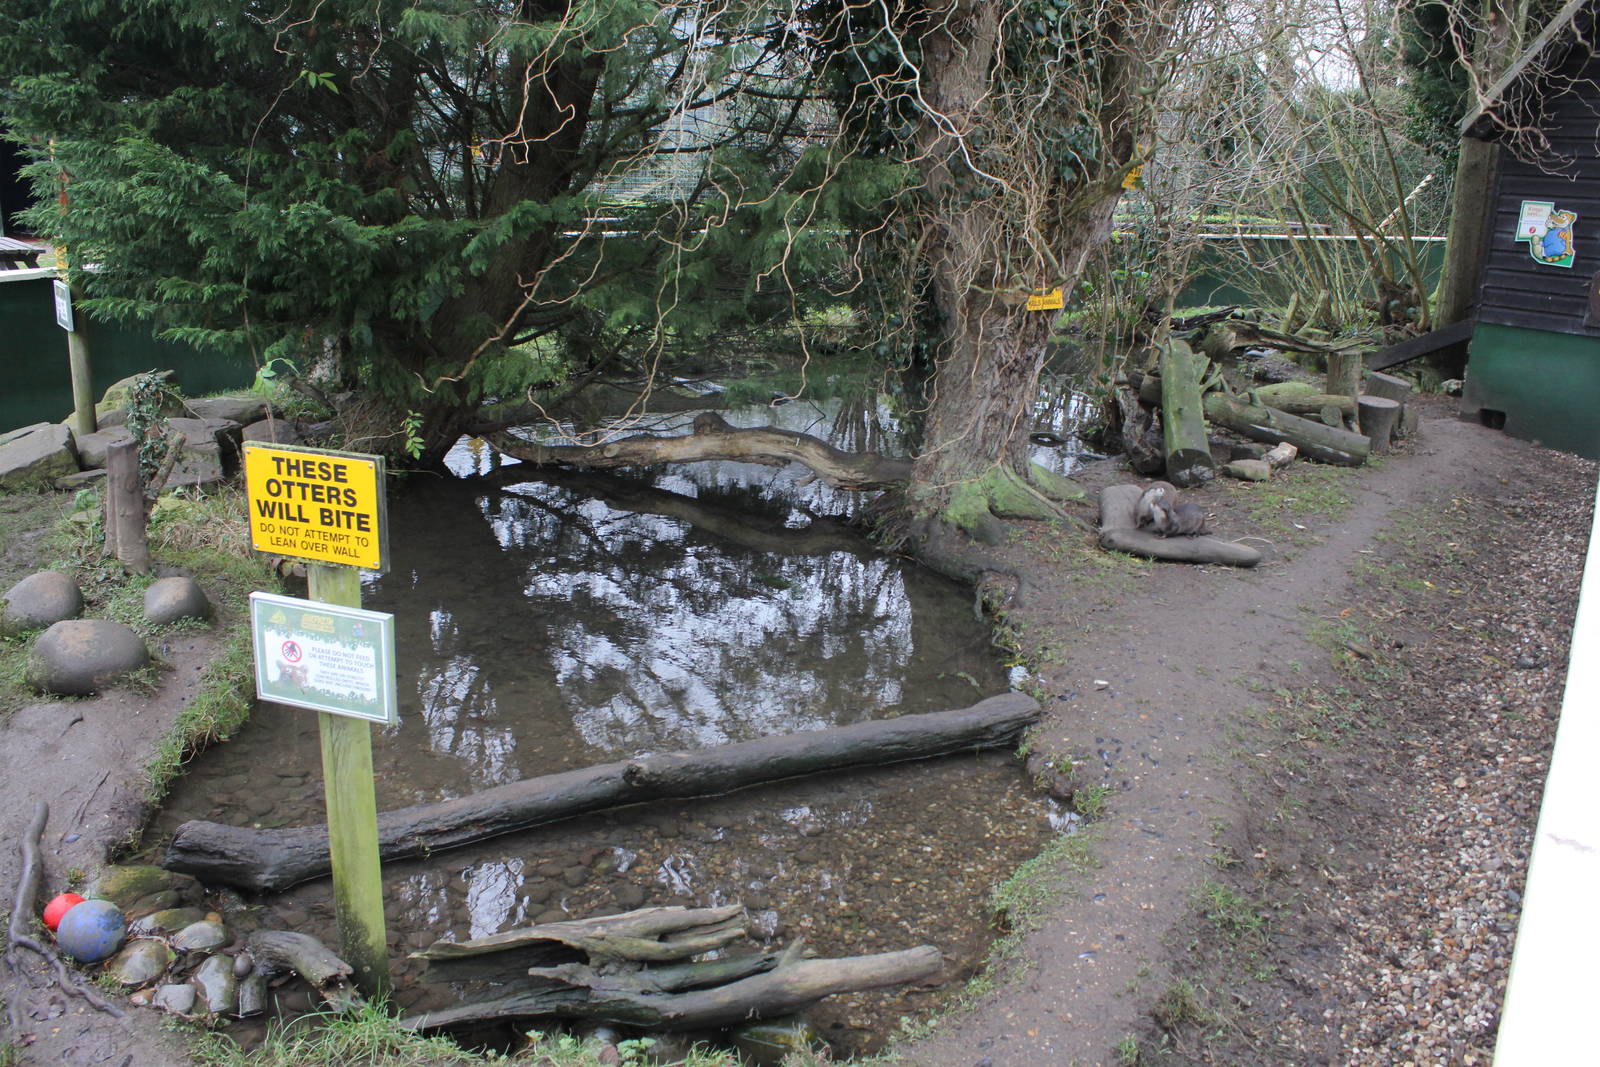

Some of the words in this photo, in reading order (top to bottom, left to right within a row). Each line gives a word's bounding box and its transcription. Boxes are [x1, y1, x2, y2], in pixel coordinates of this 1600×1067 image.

[272, 456, 348, 483] THESE
[266, 478, 357, 508] OTTERS
[256, 499, 310, 523] WILL
[320, 507, 371, 533] BITE
[260, 522, 275, 534] DO
[280, 526, 300, 537] NOT
[304, 529, 350, 545] ATTEMPT
[355, 537, 369, 548] TO
[270, 536, 297, 548] LEAN
[301, 541, 328, 553] OVER
[333, 547, 360, 559] WALL
